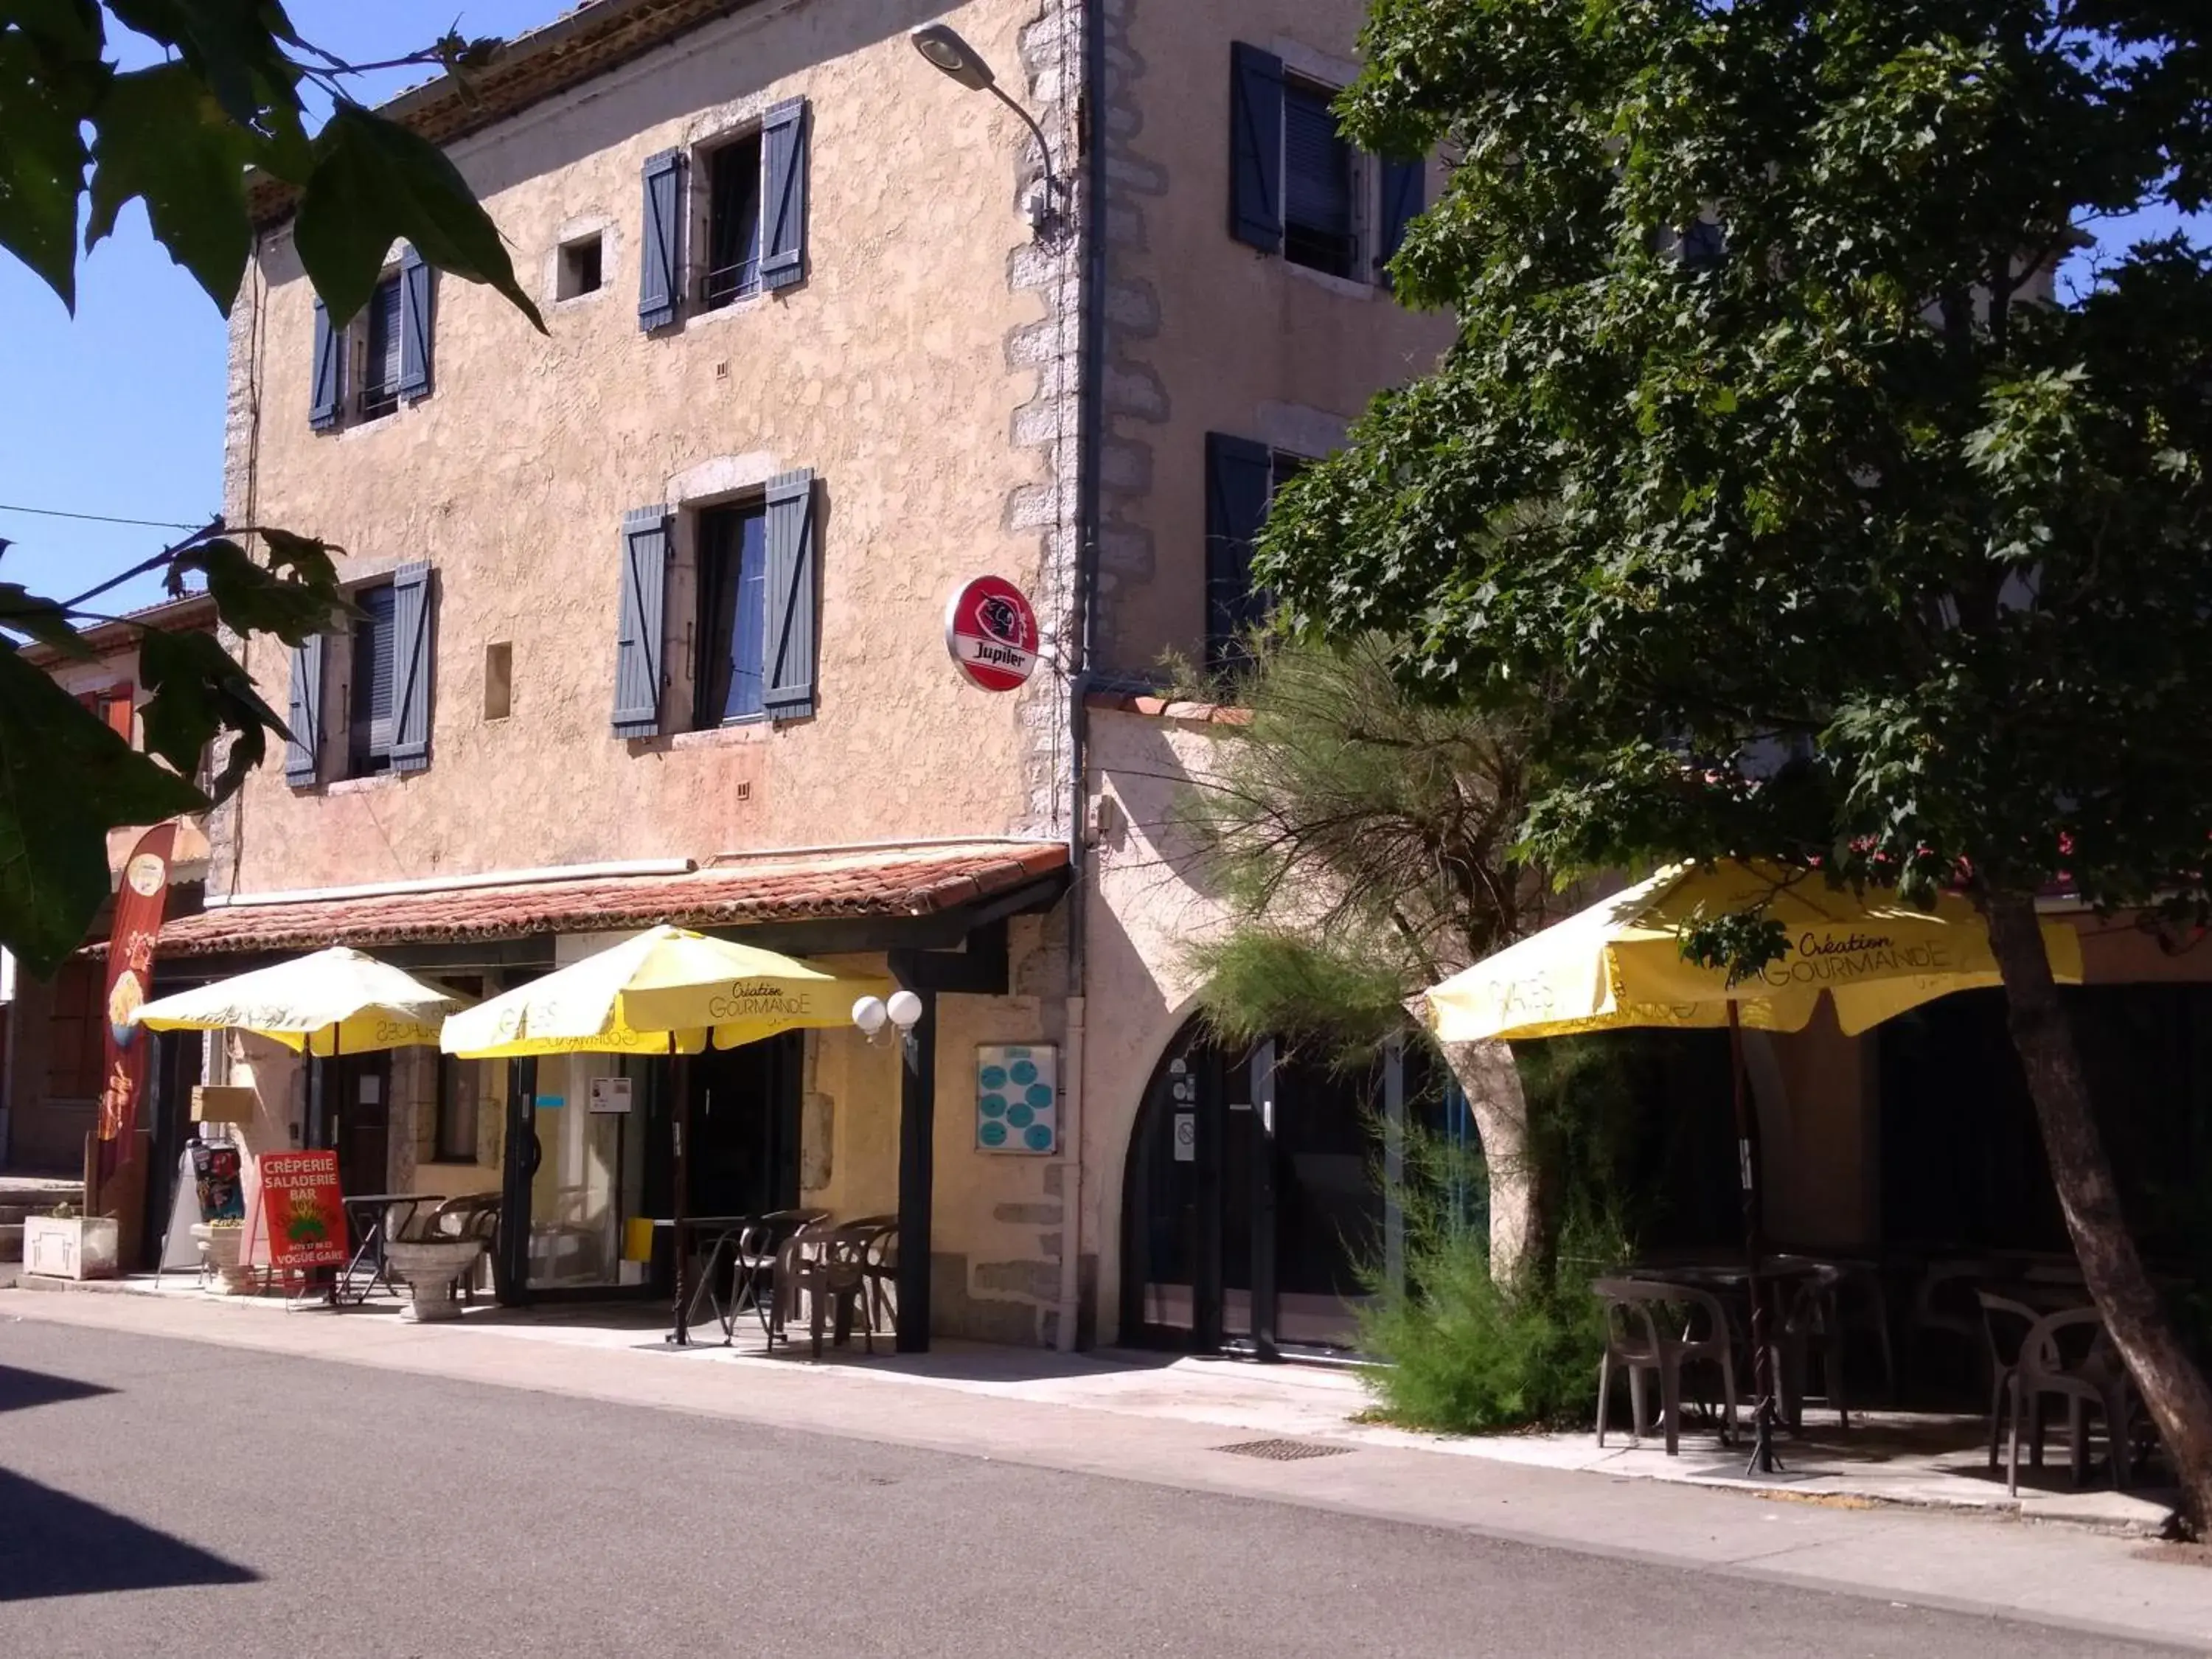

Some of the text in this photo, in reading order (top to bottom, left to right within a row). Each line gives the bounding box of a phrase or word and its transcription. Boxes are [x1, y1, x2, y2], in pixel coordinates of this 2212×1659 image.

[973, 642, 1026, 667] Jupiler
[1800, 932, 1895, 957] Création
[1763, 939, 1952, 987] GOURMANDE
[709, 993, 811, 1018] GOURMANDE
[265, 1173, 338, 1189] SALADERIE
[290, 1188, 316, 1200] BAR
